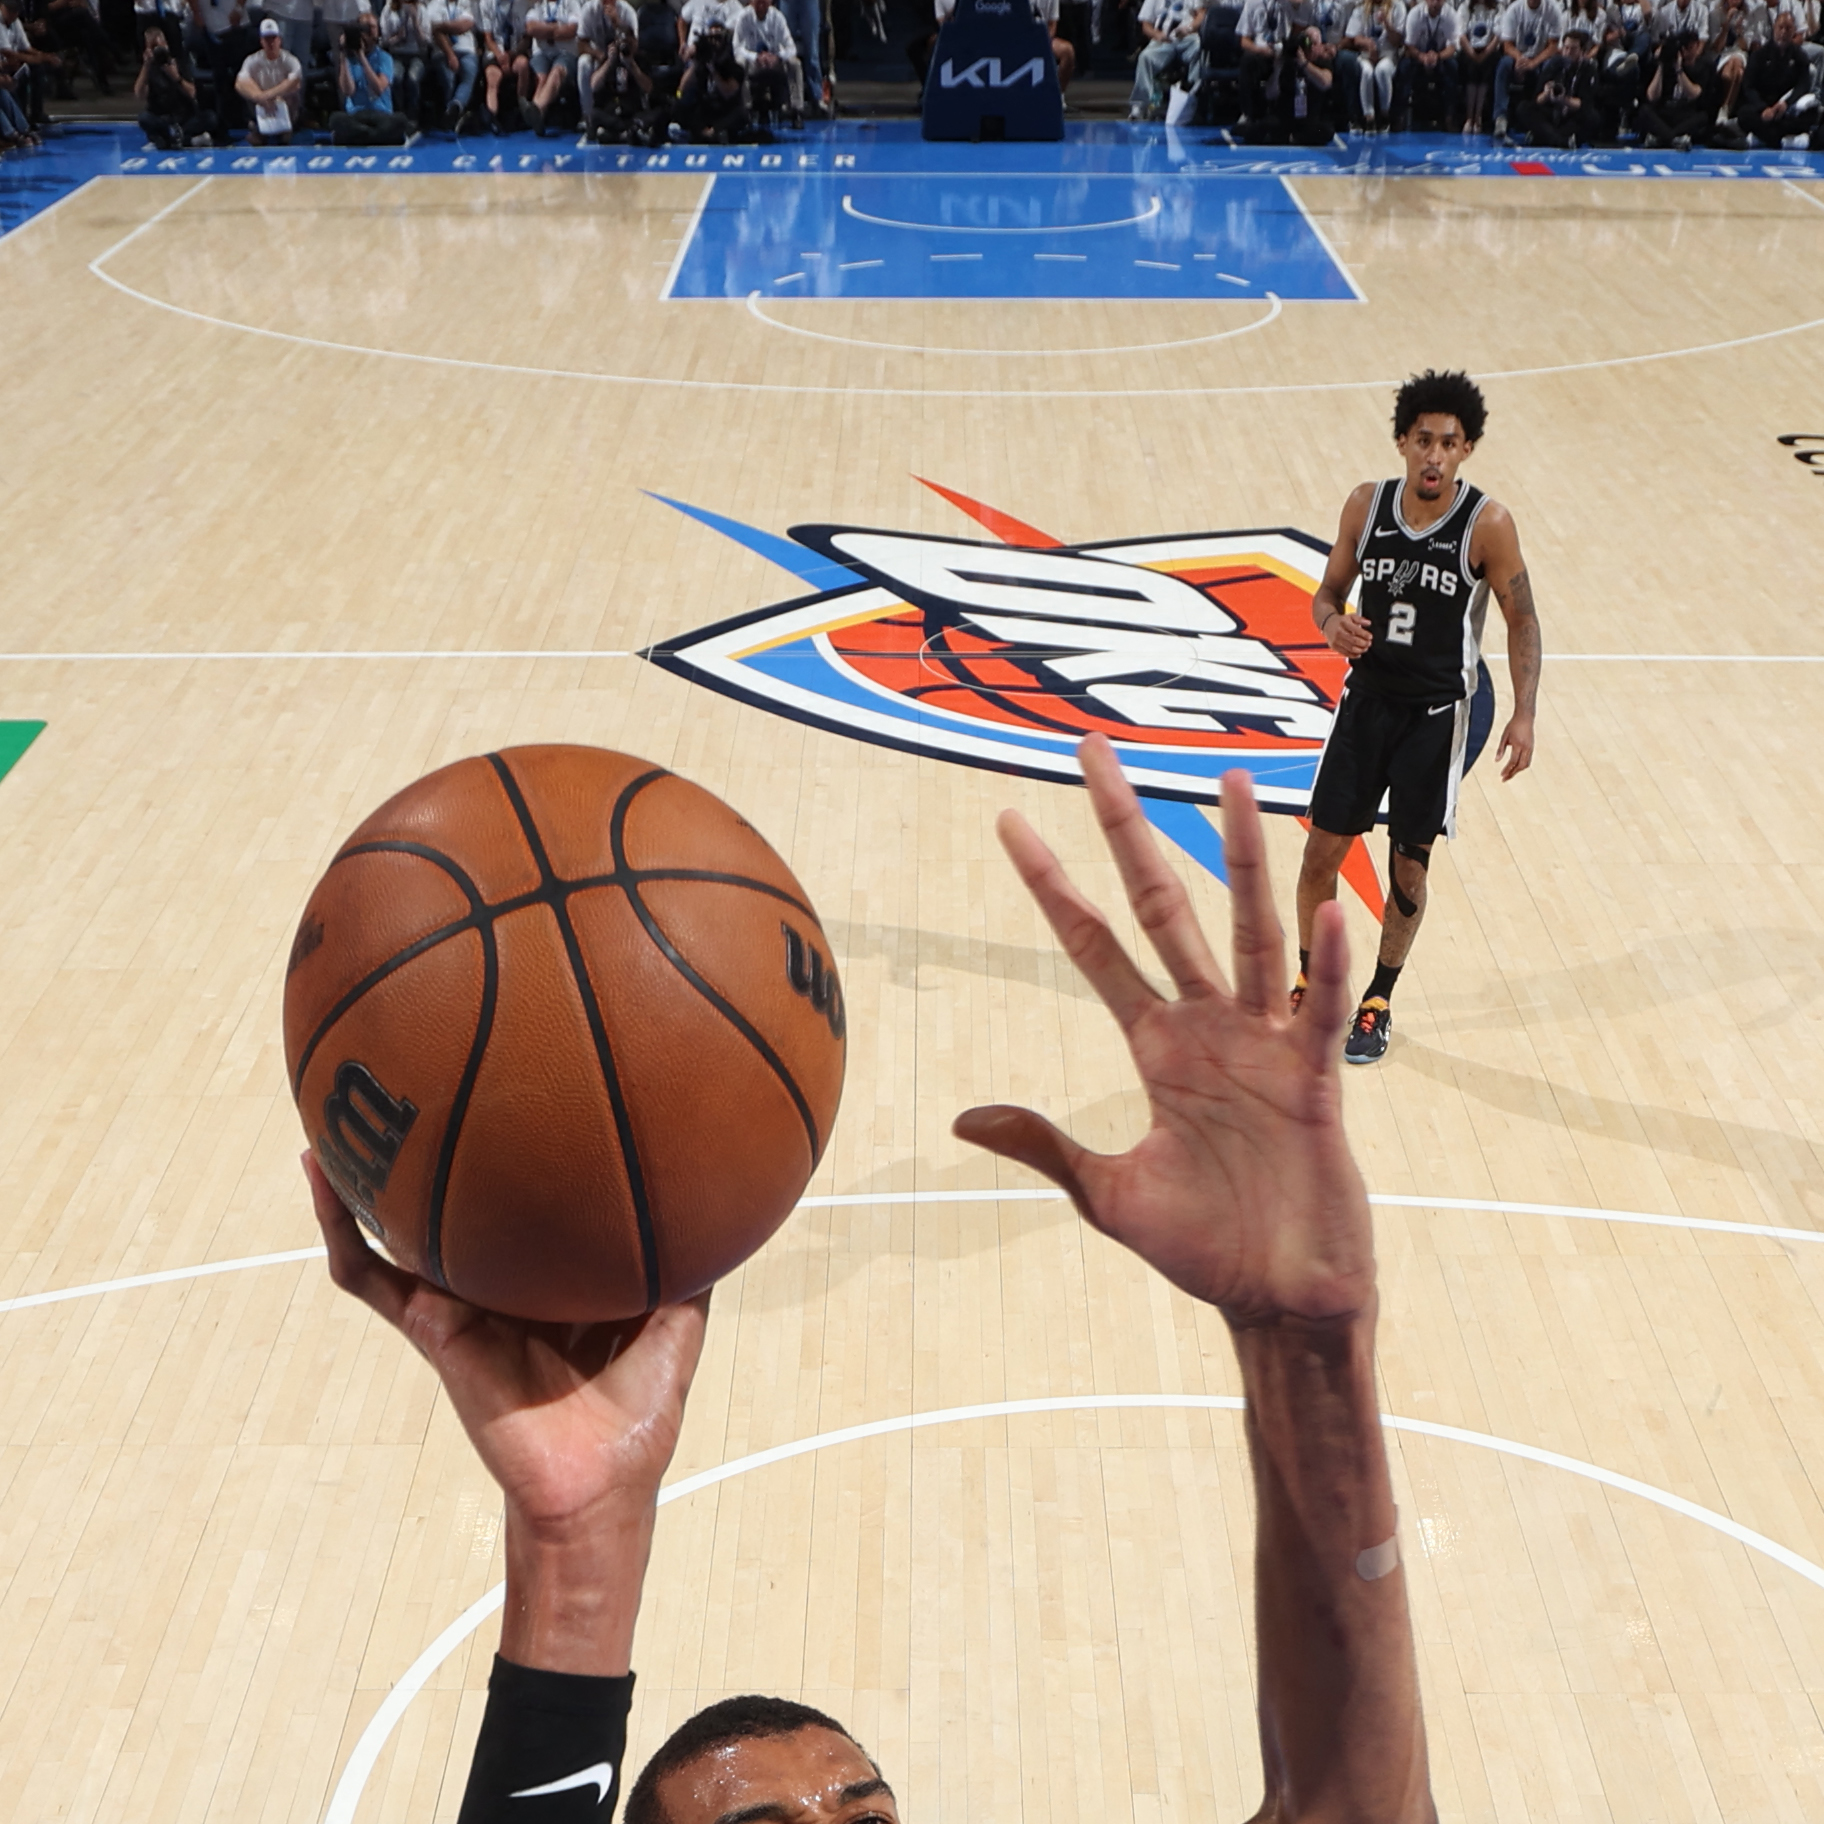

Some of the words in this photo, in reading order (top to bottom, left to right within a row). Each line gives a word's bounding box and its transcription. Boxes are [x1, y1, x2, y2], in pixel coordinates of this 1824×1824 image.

[120, 155, 414, 171] OKLAHOMA
[452, 154, 571, 169] CITY
[616, 153, 856, 168] THUNDER
[1362, 558, 1458, 597] SPURS
[1385, 602, 1417, 647] 2
